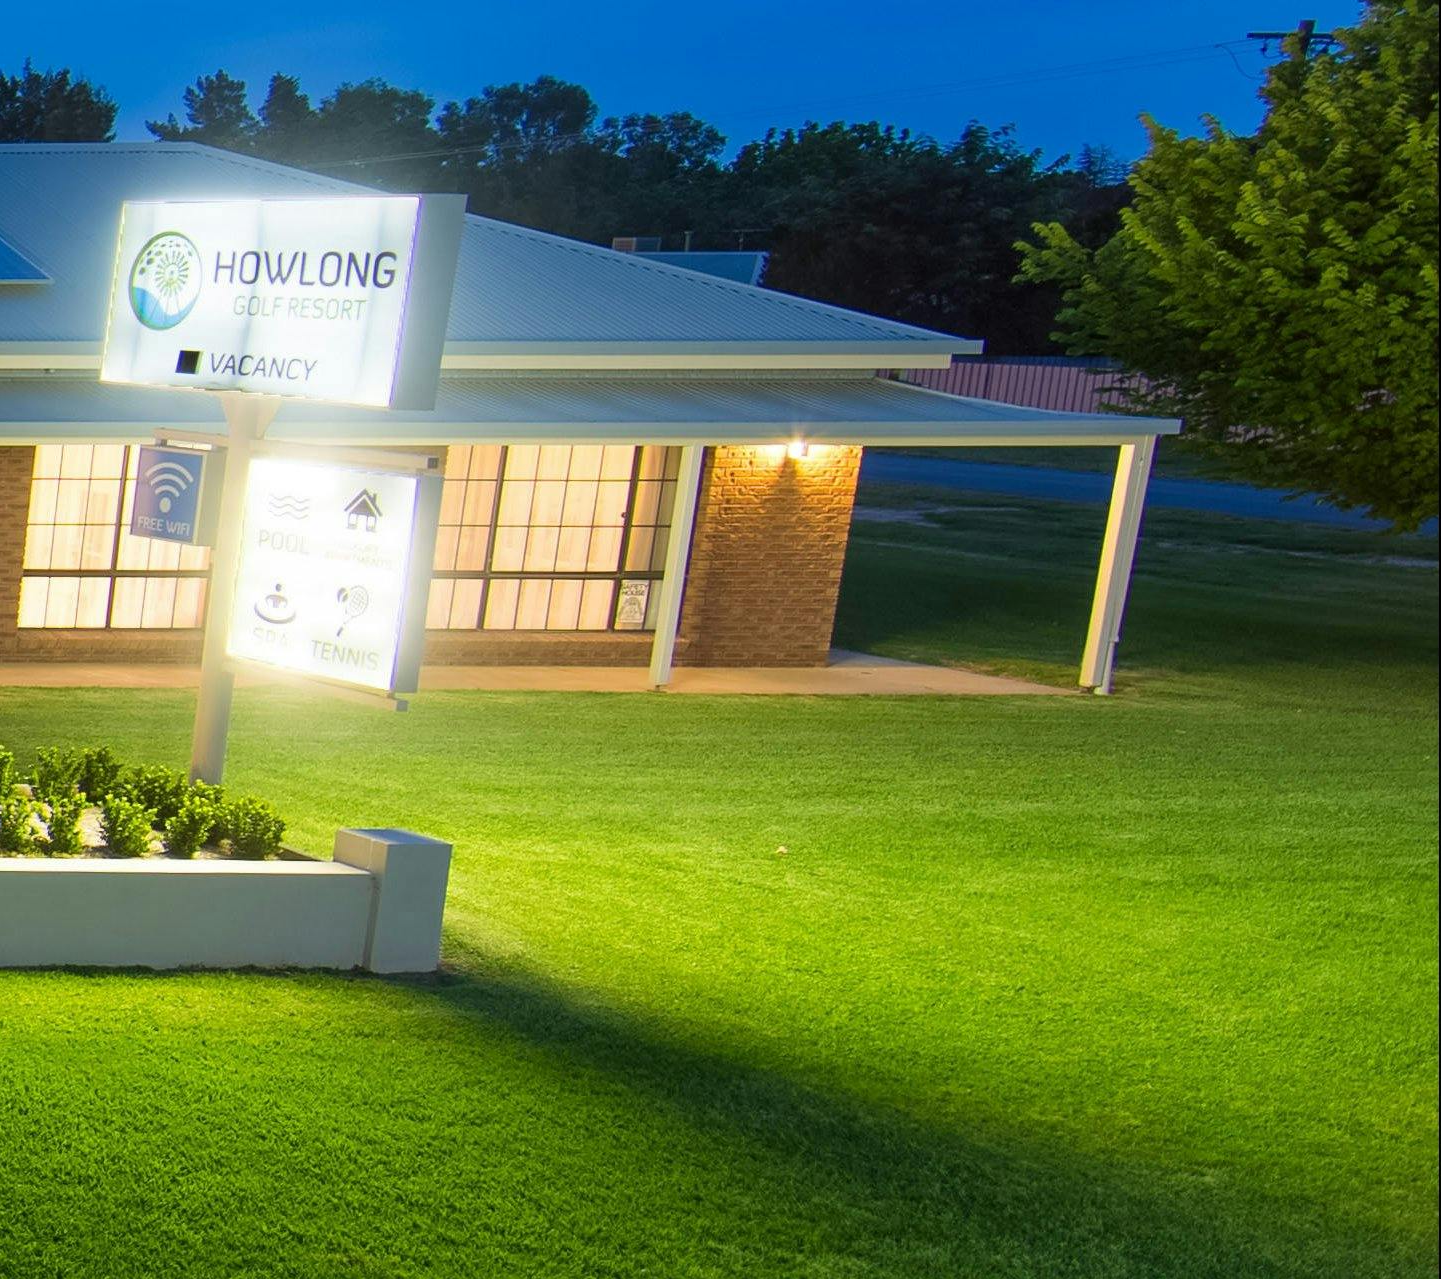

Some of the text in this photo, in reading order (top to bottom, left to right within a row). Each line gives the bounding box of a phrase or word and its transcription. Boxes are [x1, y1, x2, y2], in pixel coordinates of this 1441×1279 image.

[214, 250, 398, 289] HOWLONG
[233, 295, 368, 321] GOLF RESORT
[210, 352, 318, 381] VACANCY
[137, 516, 164, 531] FREE
[258, 529, 310, 556] POOL
[311, 639, 379, 671] TENNIS
